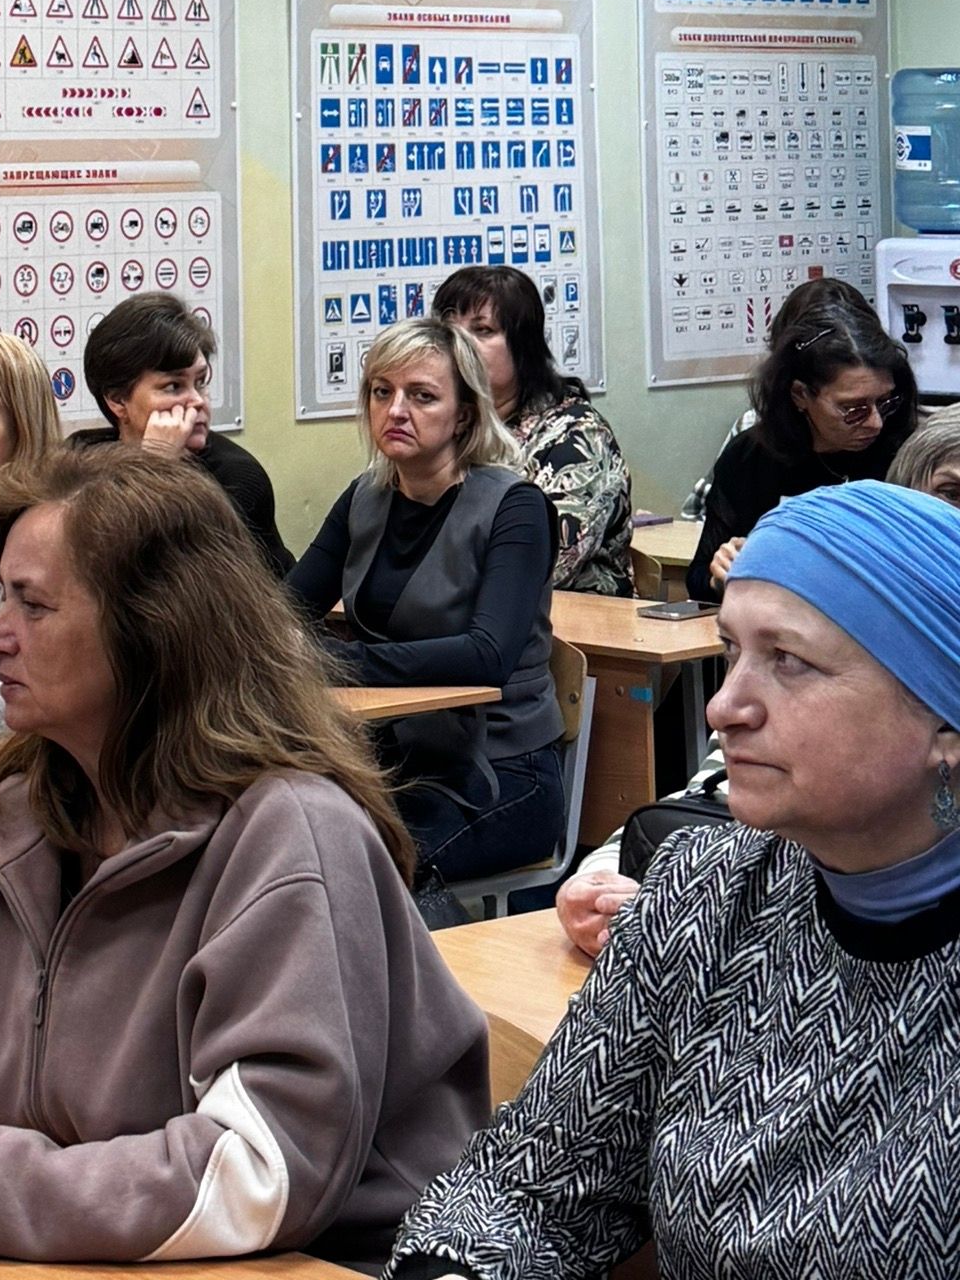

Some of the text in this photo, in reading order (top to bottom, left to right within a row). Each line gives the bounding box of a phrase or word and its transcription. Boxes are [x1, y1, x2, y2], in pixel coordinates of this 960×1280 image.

[387, 12, 414, 21] ЗНАКИ
[3, 169, 117, 180] ЗАПРЕЩАЮЩИЕ ЗНАКИ
